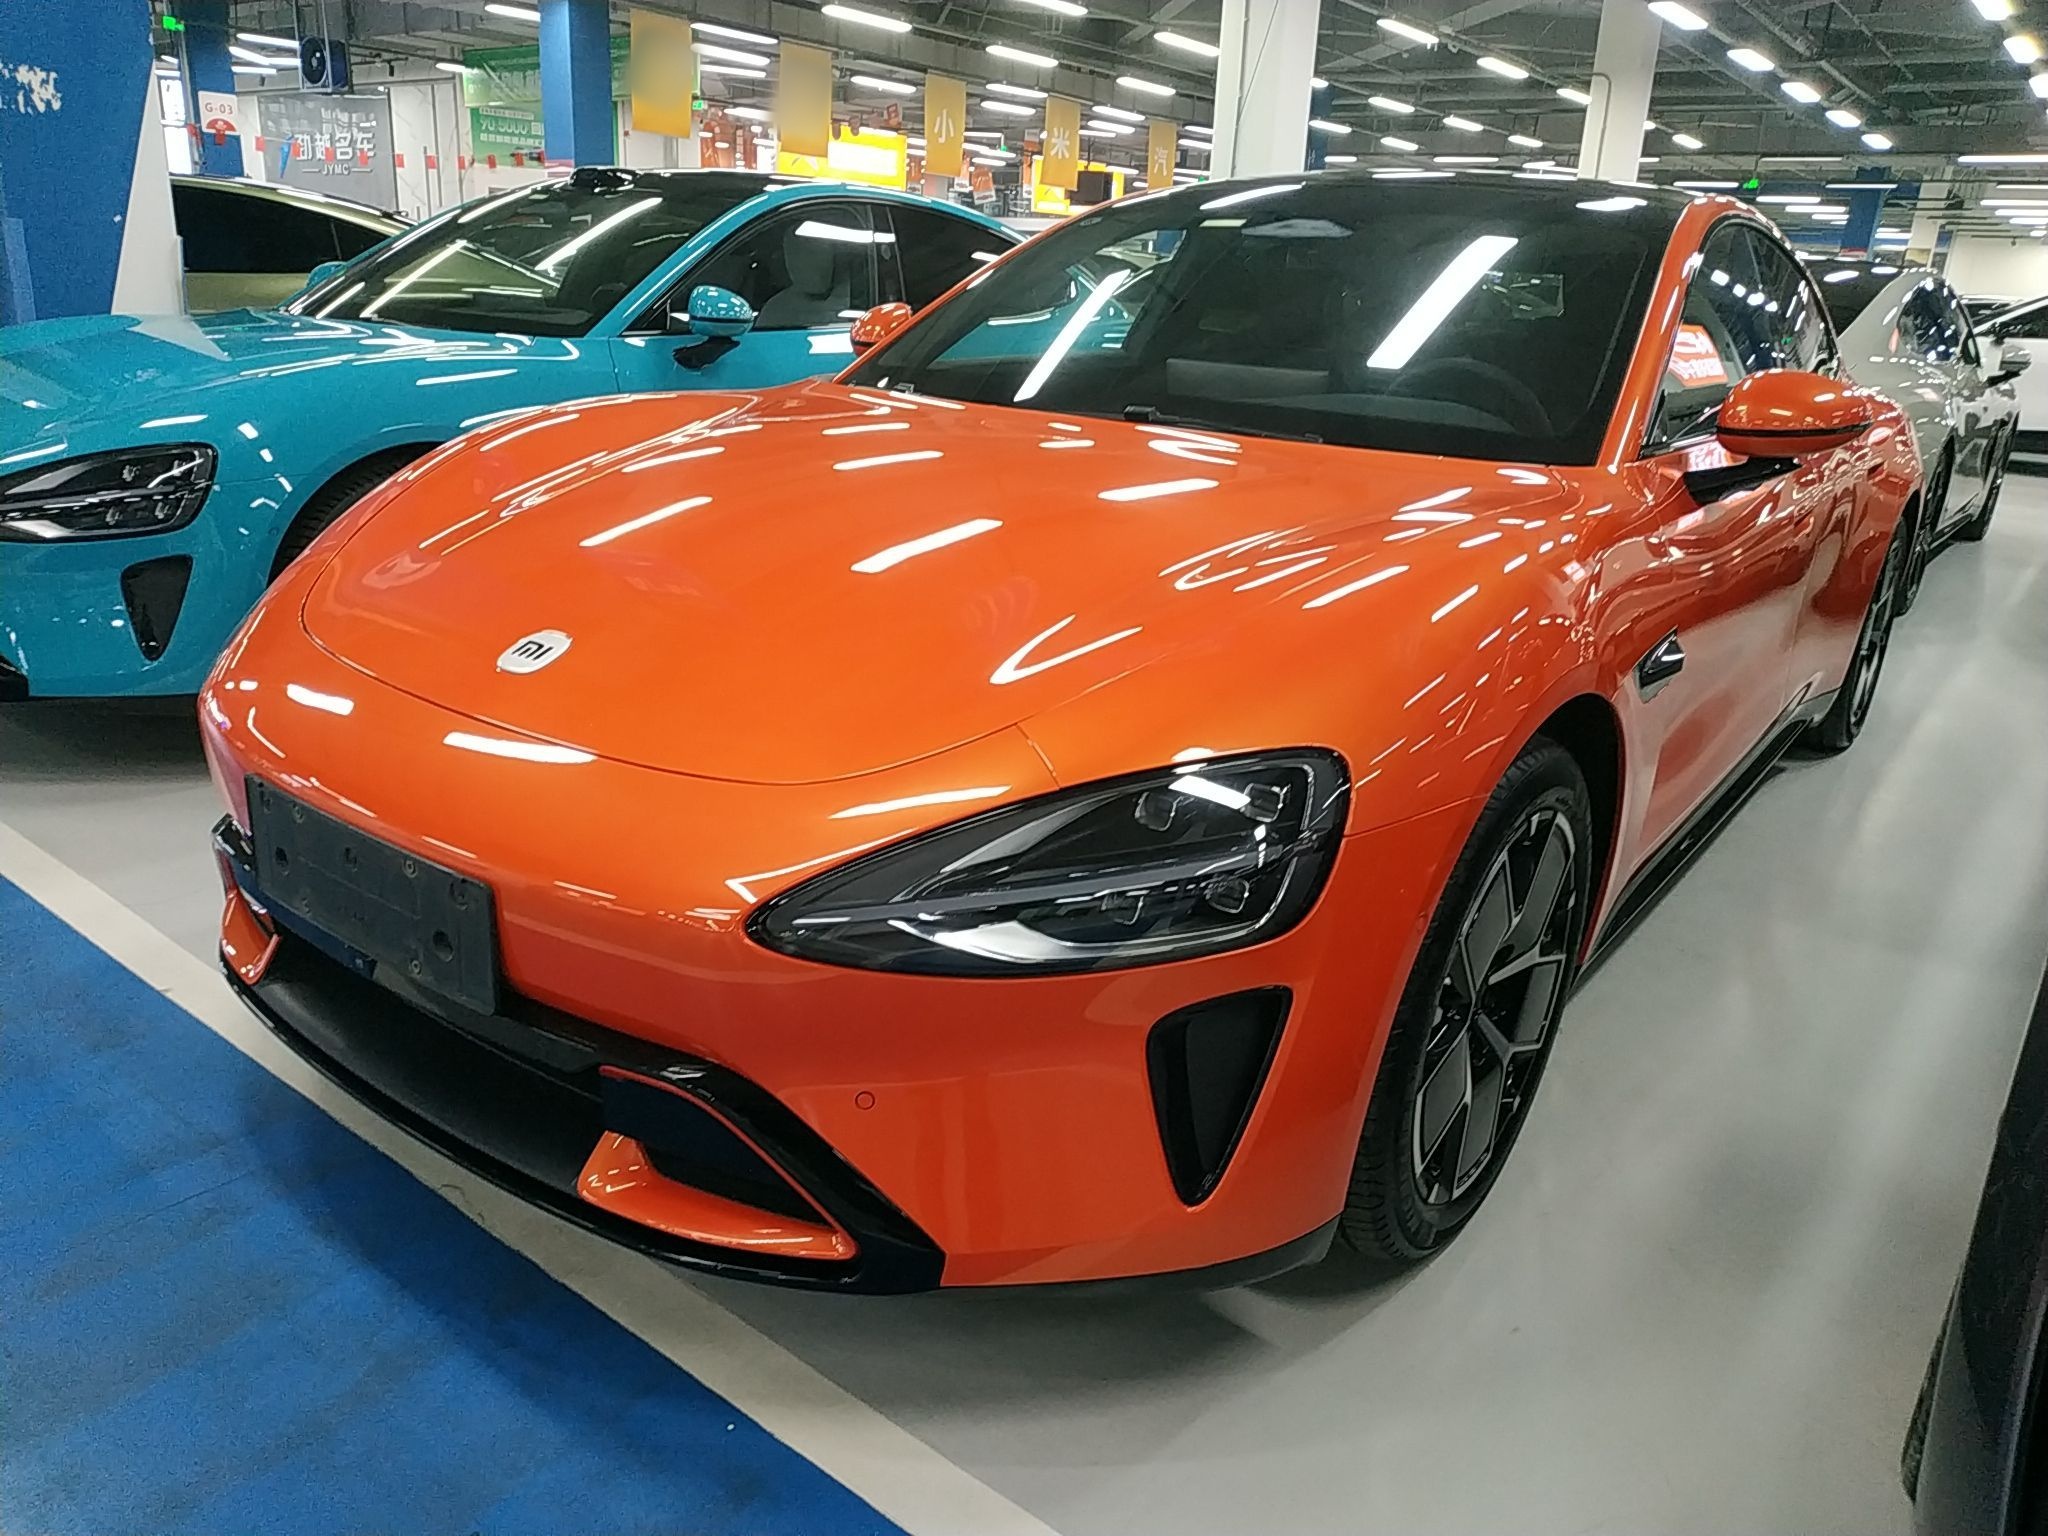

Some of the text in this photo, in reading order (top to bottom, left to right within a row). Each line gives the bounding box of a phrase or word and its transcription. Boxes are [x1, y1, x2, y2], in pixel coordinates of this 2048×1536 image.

[204, 102, 234, 116] G-03
[933, 108, 955, 144] 小
[1050, 126, 1070, 160] 米
[322, 163, 350, 176] JYMC
[1154, 146, 1168, 177] 汽
